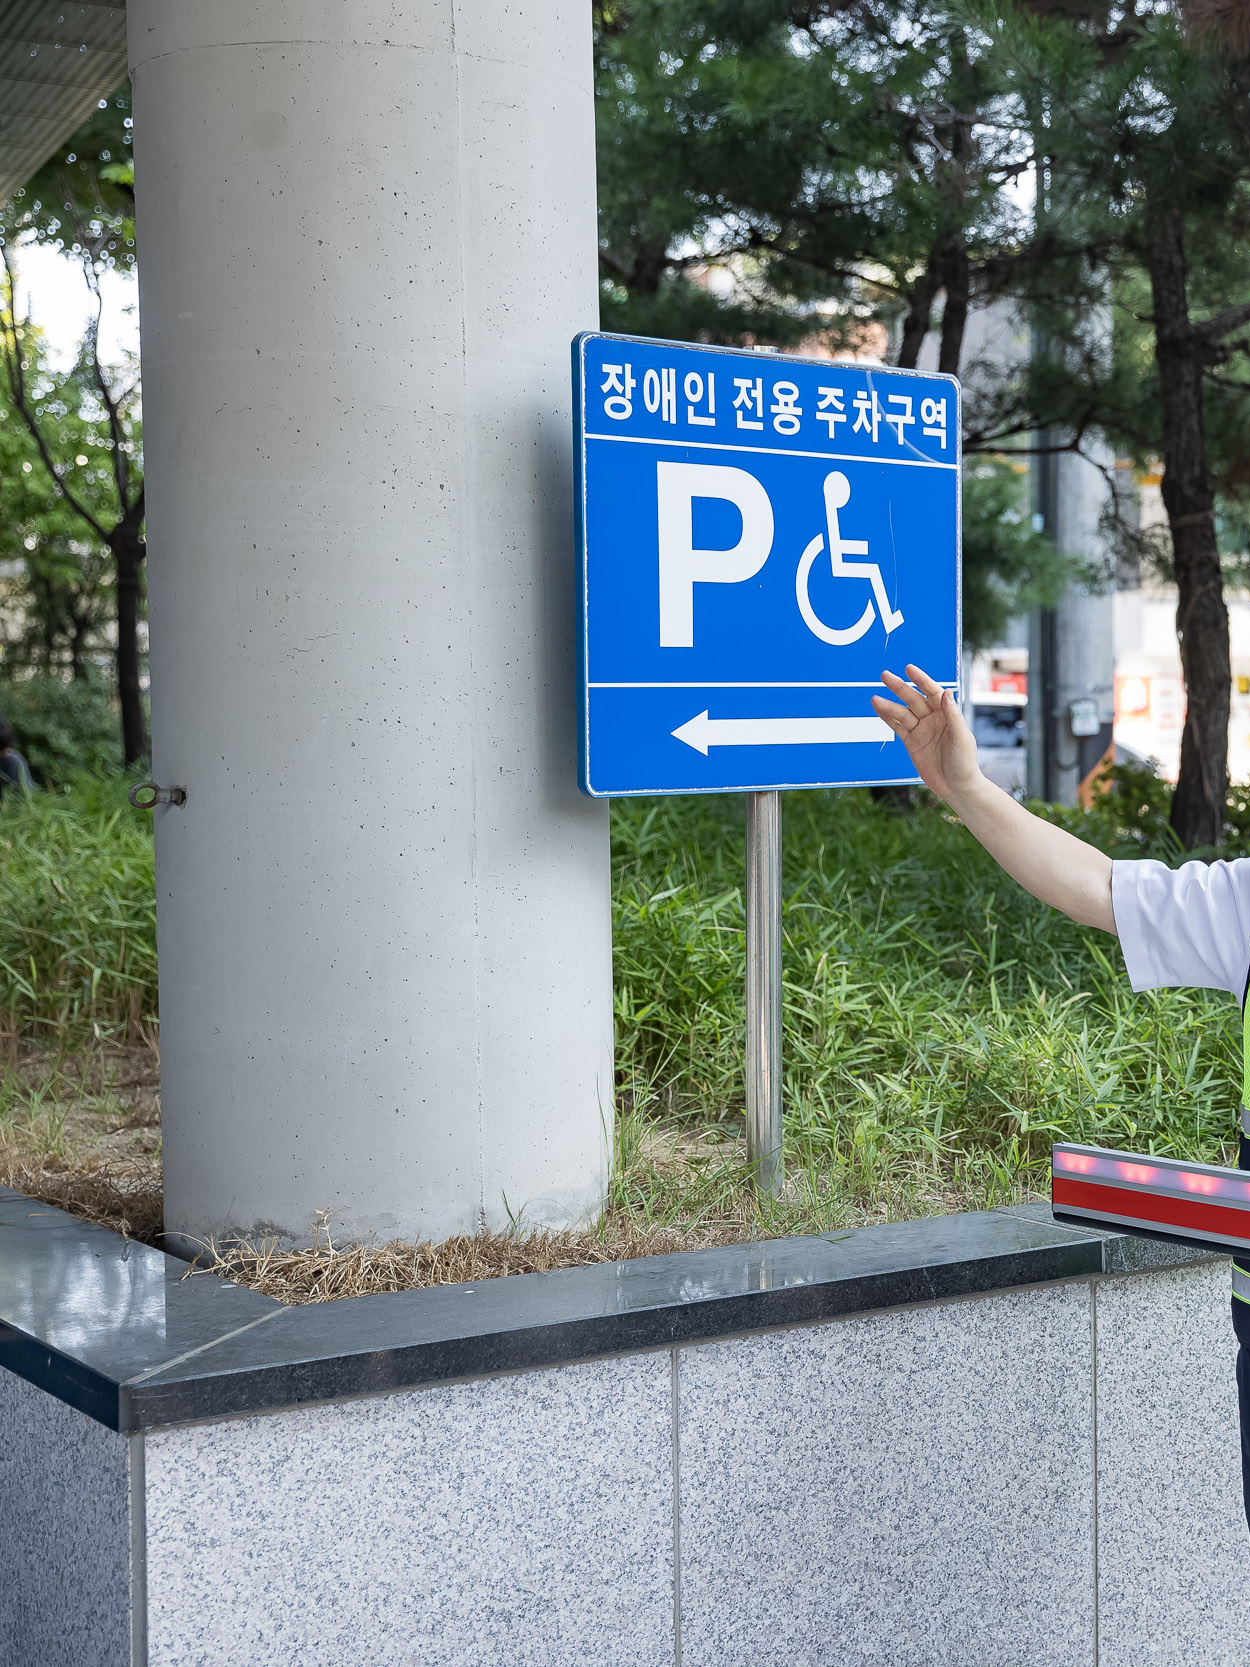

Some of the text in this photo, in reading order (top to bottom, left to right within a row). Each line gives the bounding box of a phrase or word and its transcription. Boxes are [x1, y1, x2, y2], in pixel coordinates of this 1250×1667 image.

[600, 363, 948, 450] 장애인 전용 주차구역
[656, 460, 775, 648] P
